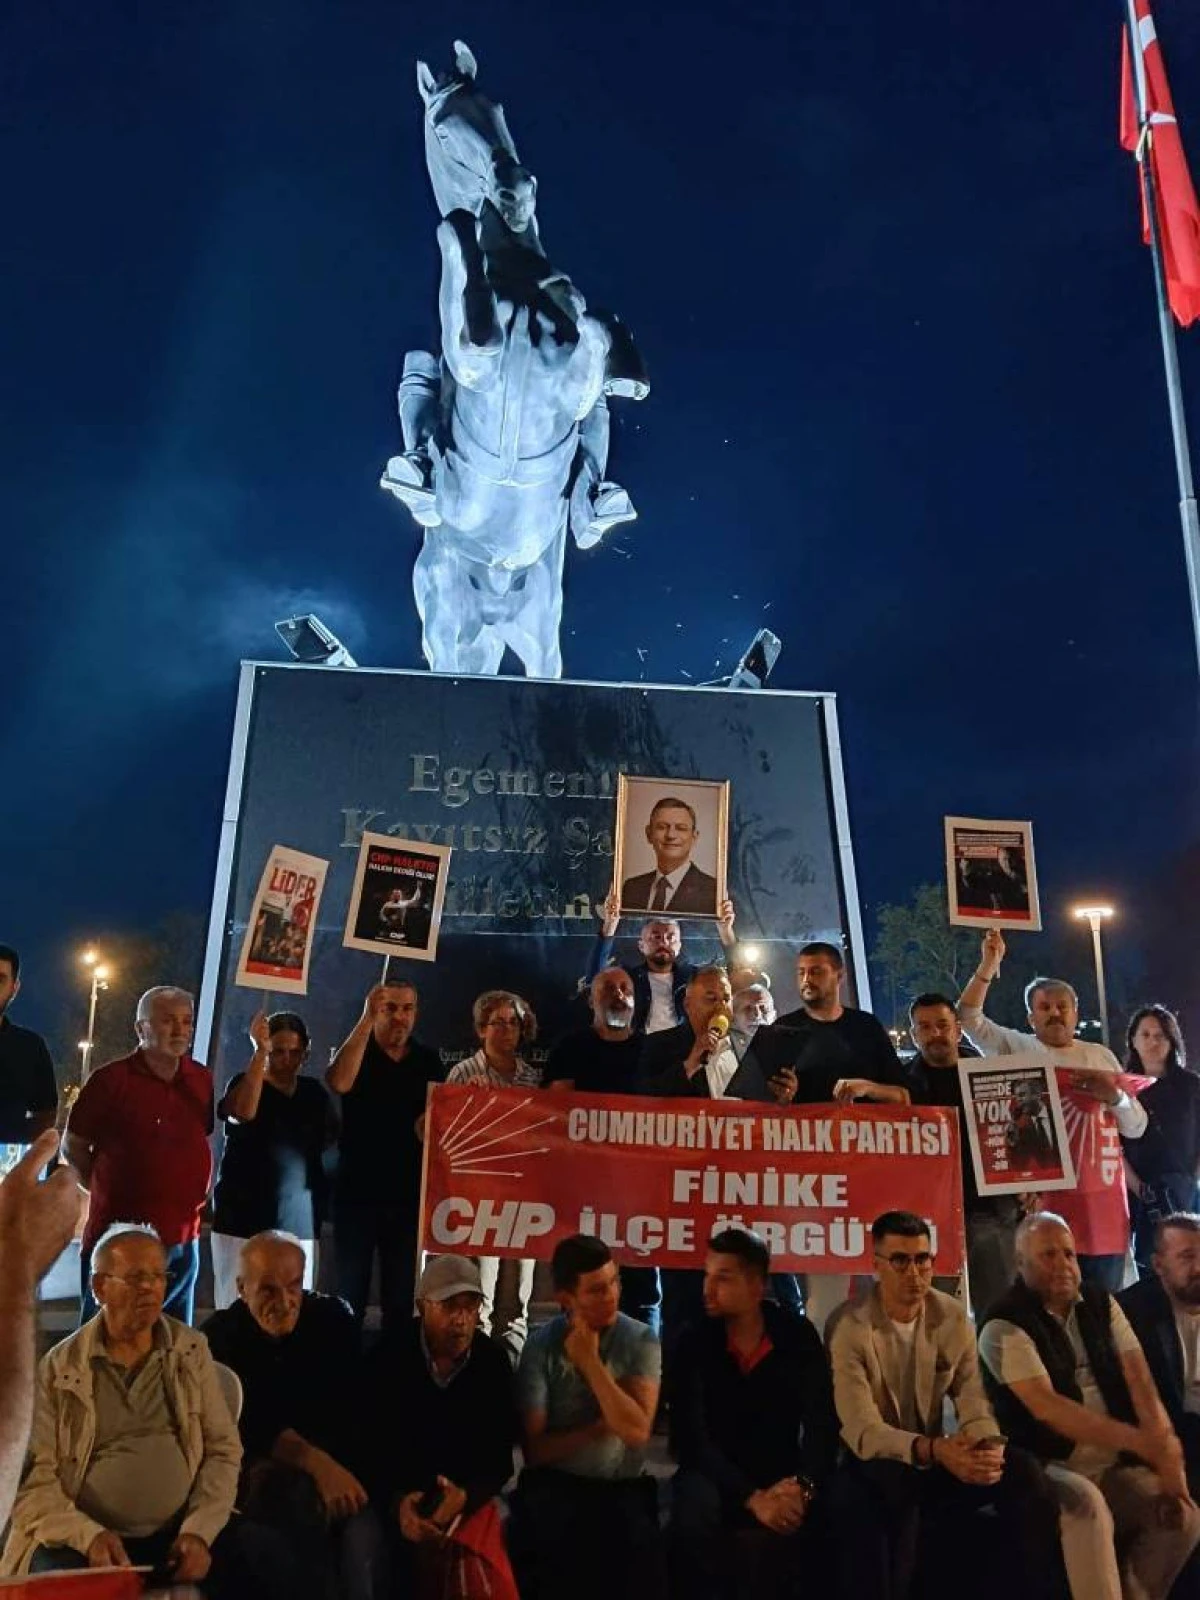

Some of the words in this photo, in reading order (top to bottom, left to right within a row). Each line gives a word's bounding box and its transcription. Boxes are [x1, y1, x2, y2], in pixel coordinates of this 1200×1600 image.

[408, 754, 640, 808] Egemenl
[568, 1107, 755, 1152] CUMHURİYET
[763, 1113, 833, 1154] HALK
[841, 1116, 950, 1156] PARTİSİ
[976, 1099, 1013, 1124] YOK
[672, 1165, 849, 1207] FİNİKE
[430, 1196, 556, 1250] CHP
[579, 1206, 695, 1257] İLÇE
[711, 1213, 938, 1258] ÖRGÜ
